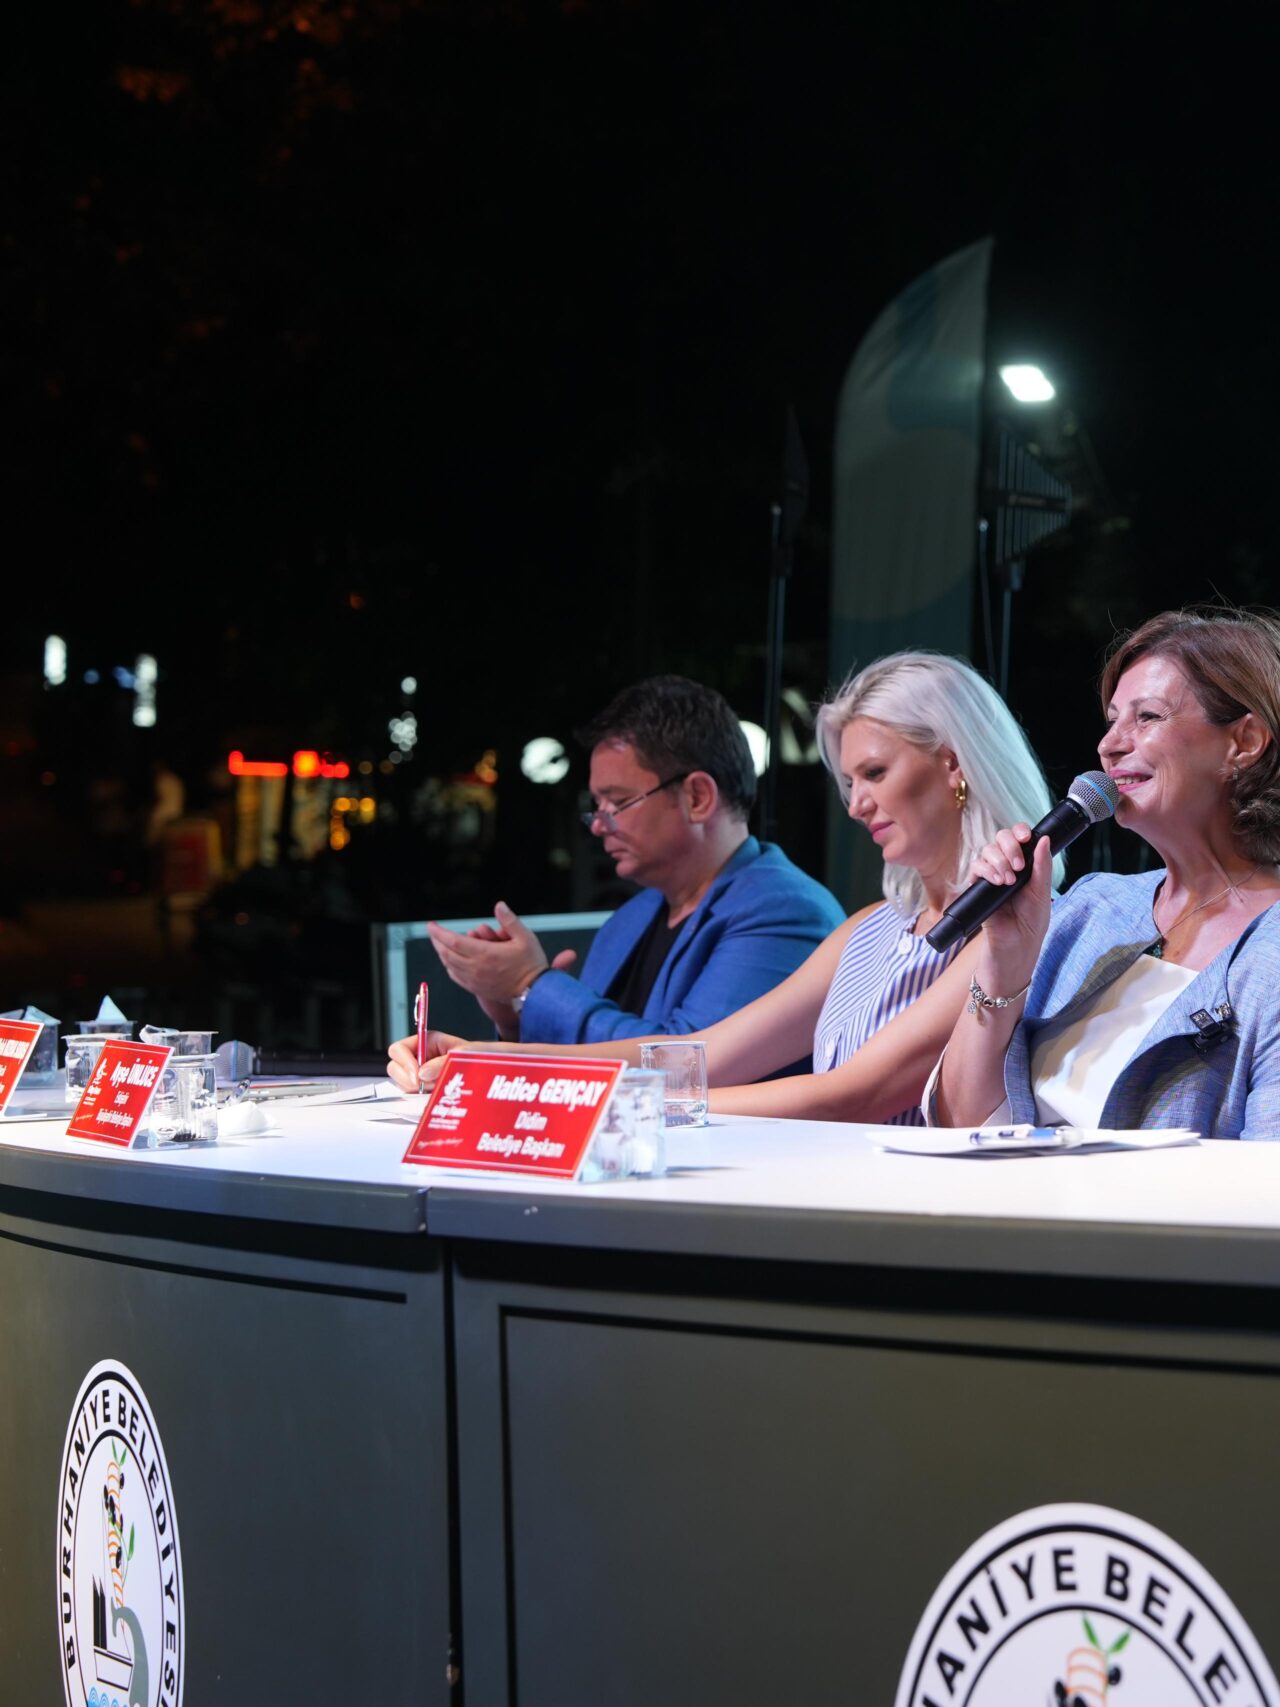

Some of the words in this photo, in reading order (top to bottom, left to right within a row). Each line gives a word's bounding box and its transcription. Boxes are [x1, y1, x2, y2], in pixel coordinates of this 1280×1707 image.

[487, 1075, 539, 1103] Hatice
[539, 1078, 607, 1112] GENÇAY
[514, 1111, 548, 1131] Didim
[63, 1389, 110, 1669] BURHANİYE
